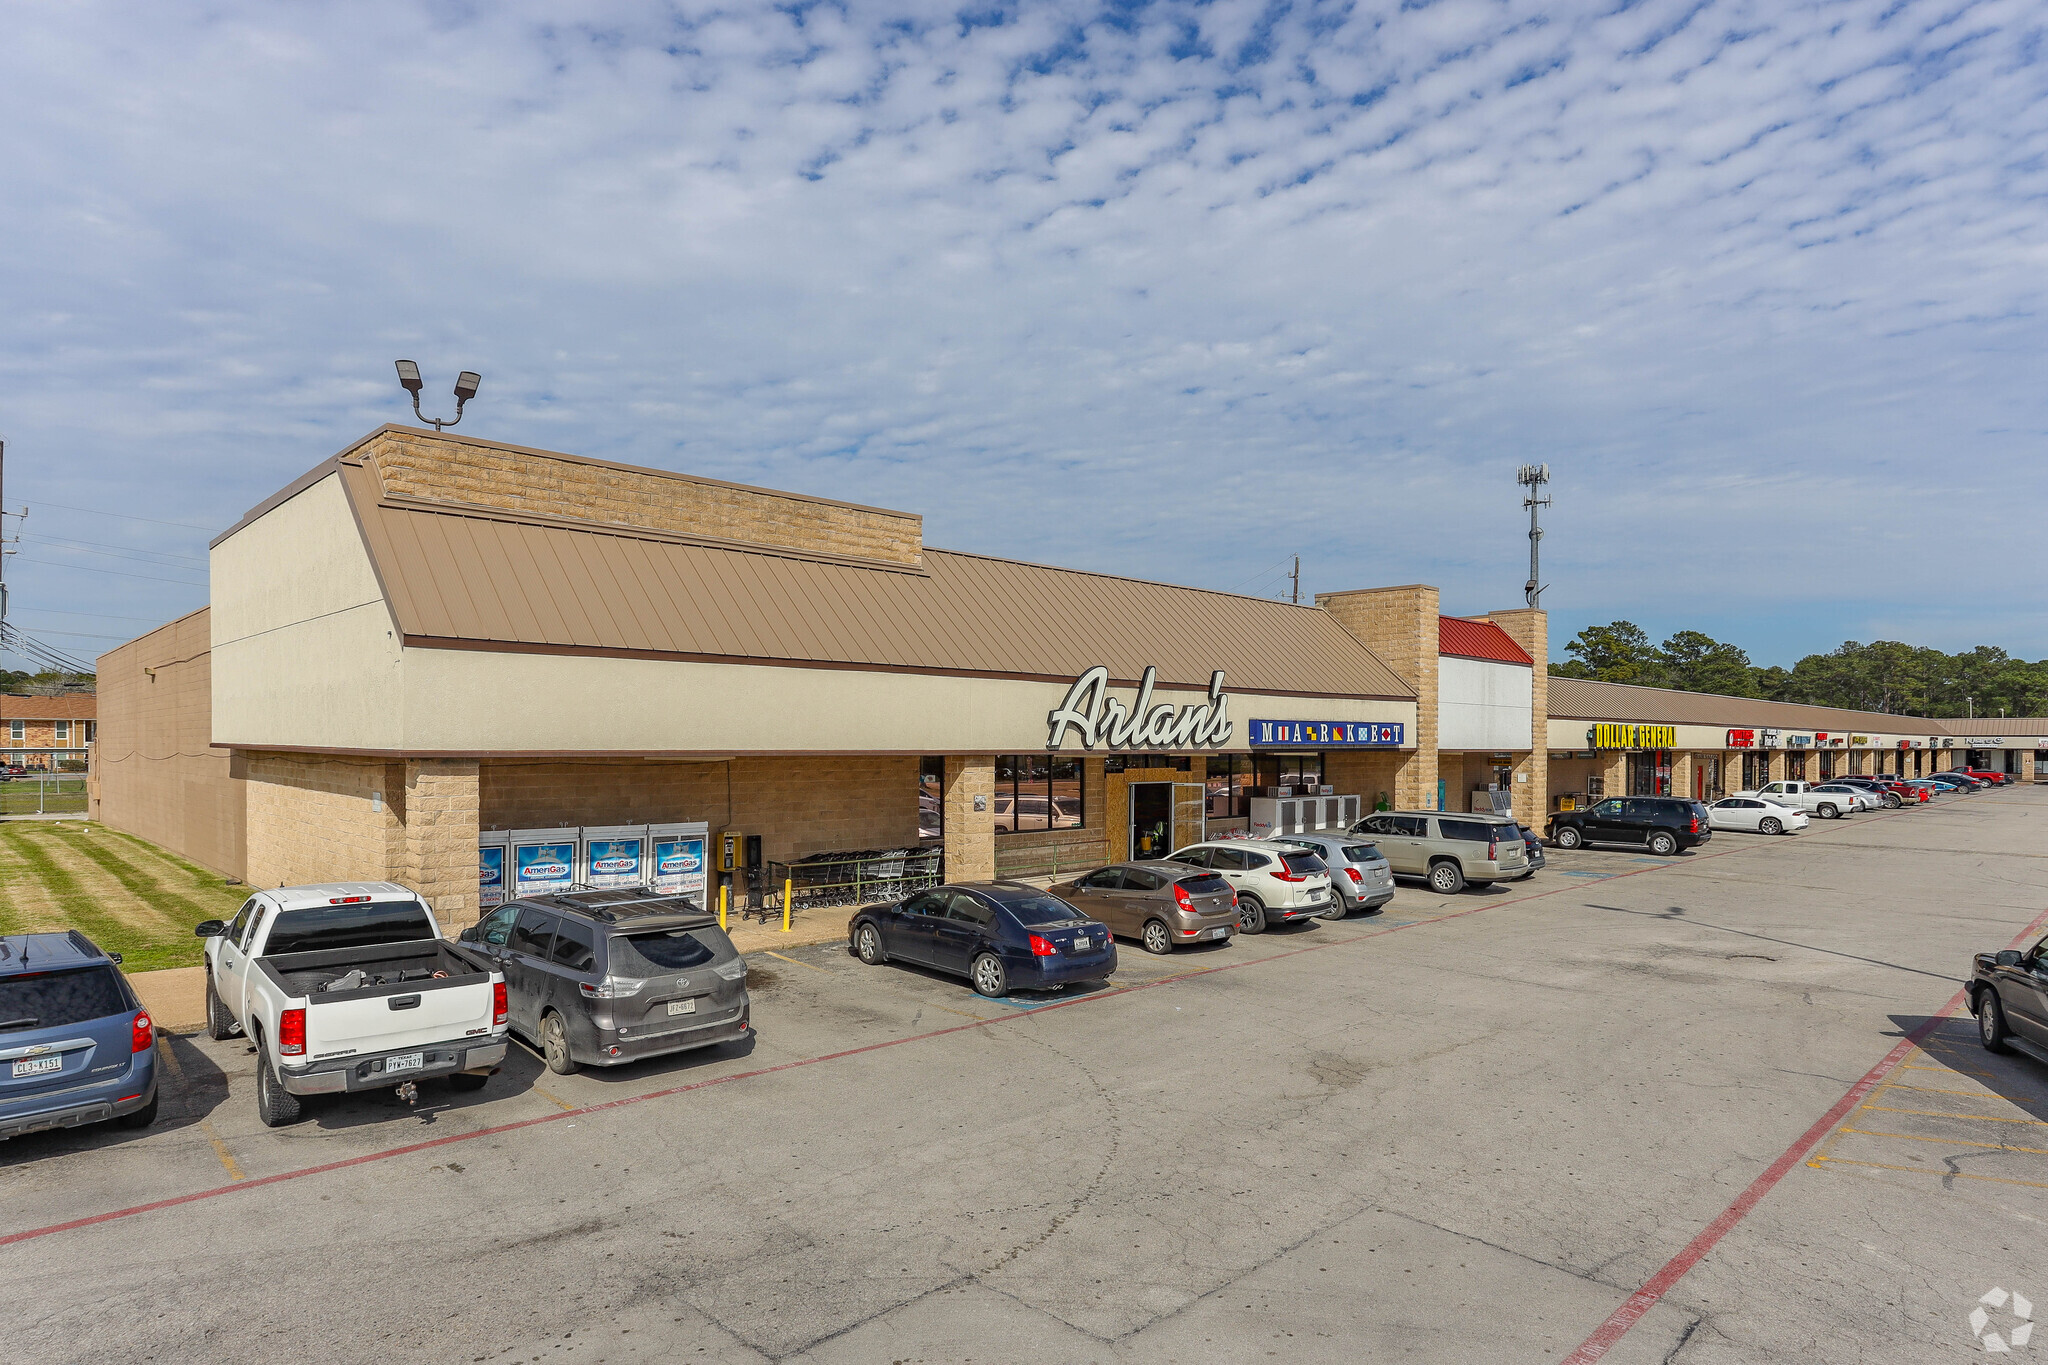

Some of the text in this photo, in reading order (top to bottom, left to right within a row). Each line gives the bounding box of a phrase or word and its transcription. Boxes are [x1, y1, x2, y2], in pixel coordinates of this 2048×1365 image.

[1048, 666, 1232, 748] Arlan's
[1595, 723, 1677, 748] DOLLAR GENERAL
[594, 860, 634, 869] AmeriGas
[661, 859, 698, 870] AmeriGas
[523, 865, 566, 875] AmeriGas
[465, 1027, 488, 1036] GMC
